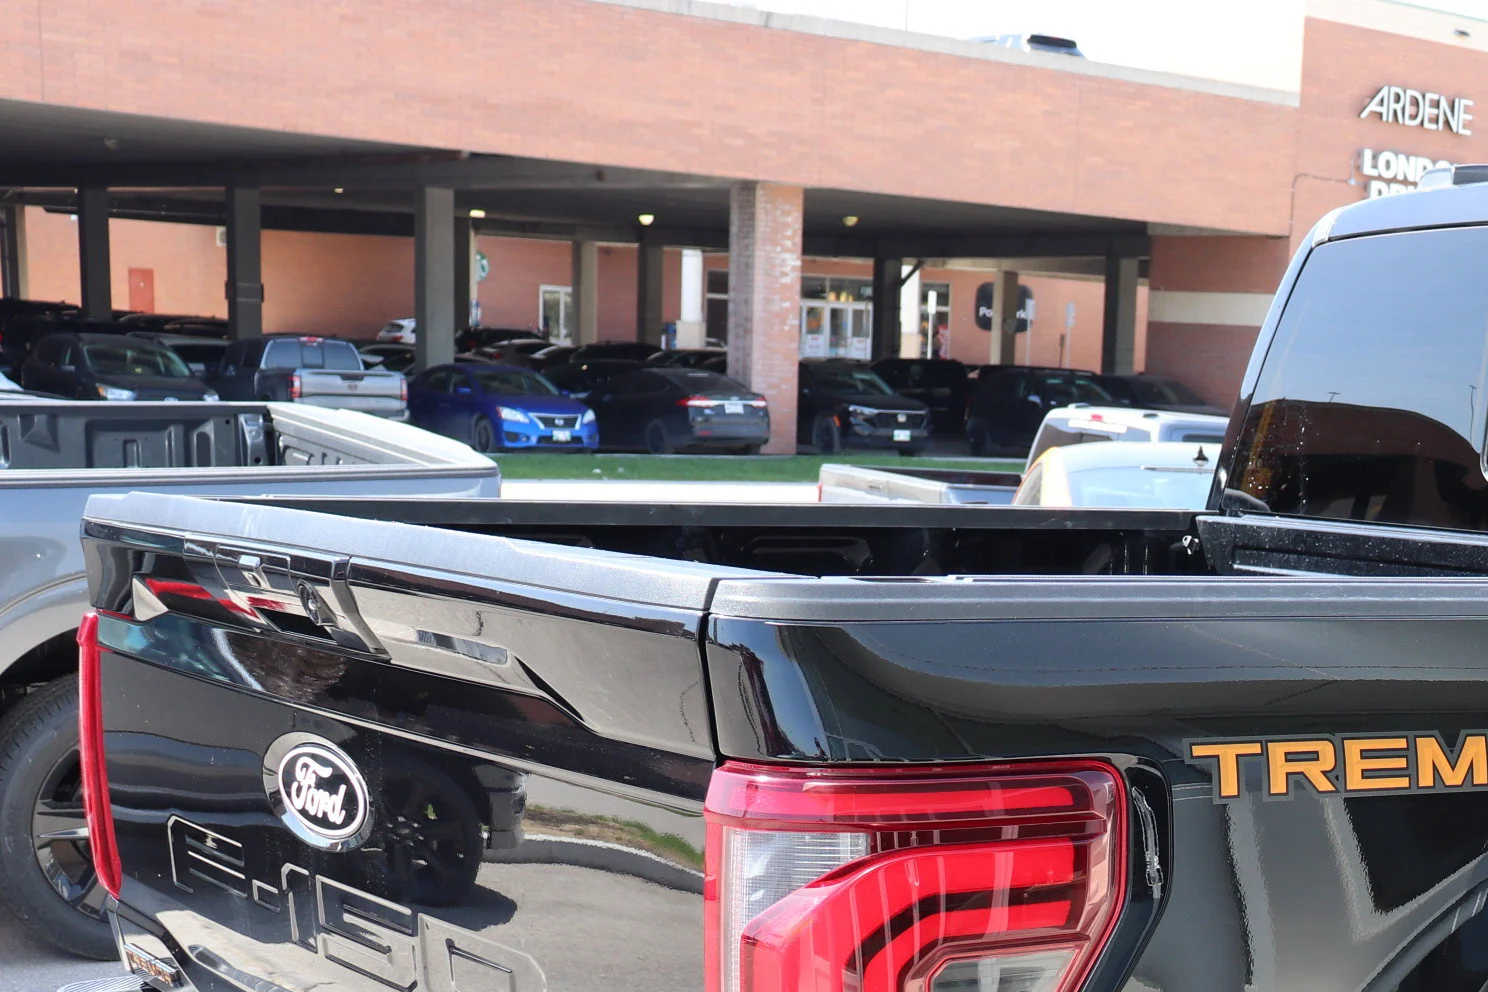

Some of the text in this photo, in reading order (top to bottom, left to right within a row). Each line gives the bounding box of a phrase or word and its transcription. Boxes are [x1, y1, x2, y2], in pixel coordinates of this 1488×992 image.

[1359, 85, 1474, 136] ARDENE
[1362, 148, 1456, 182] LOND
[289, 755, 349, 826] Ford
